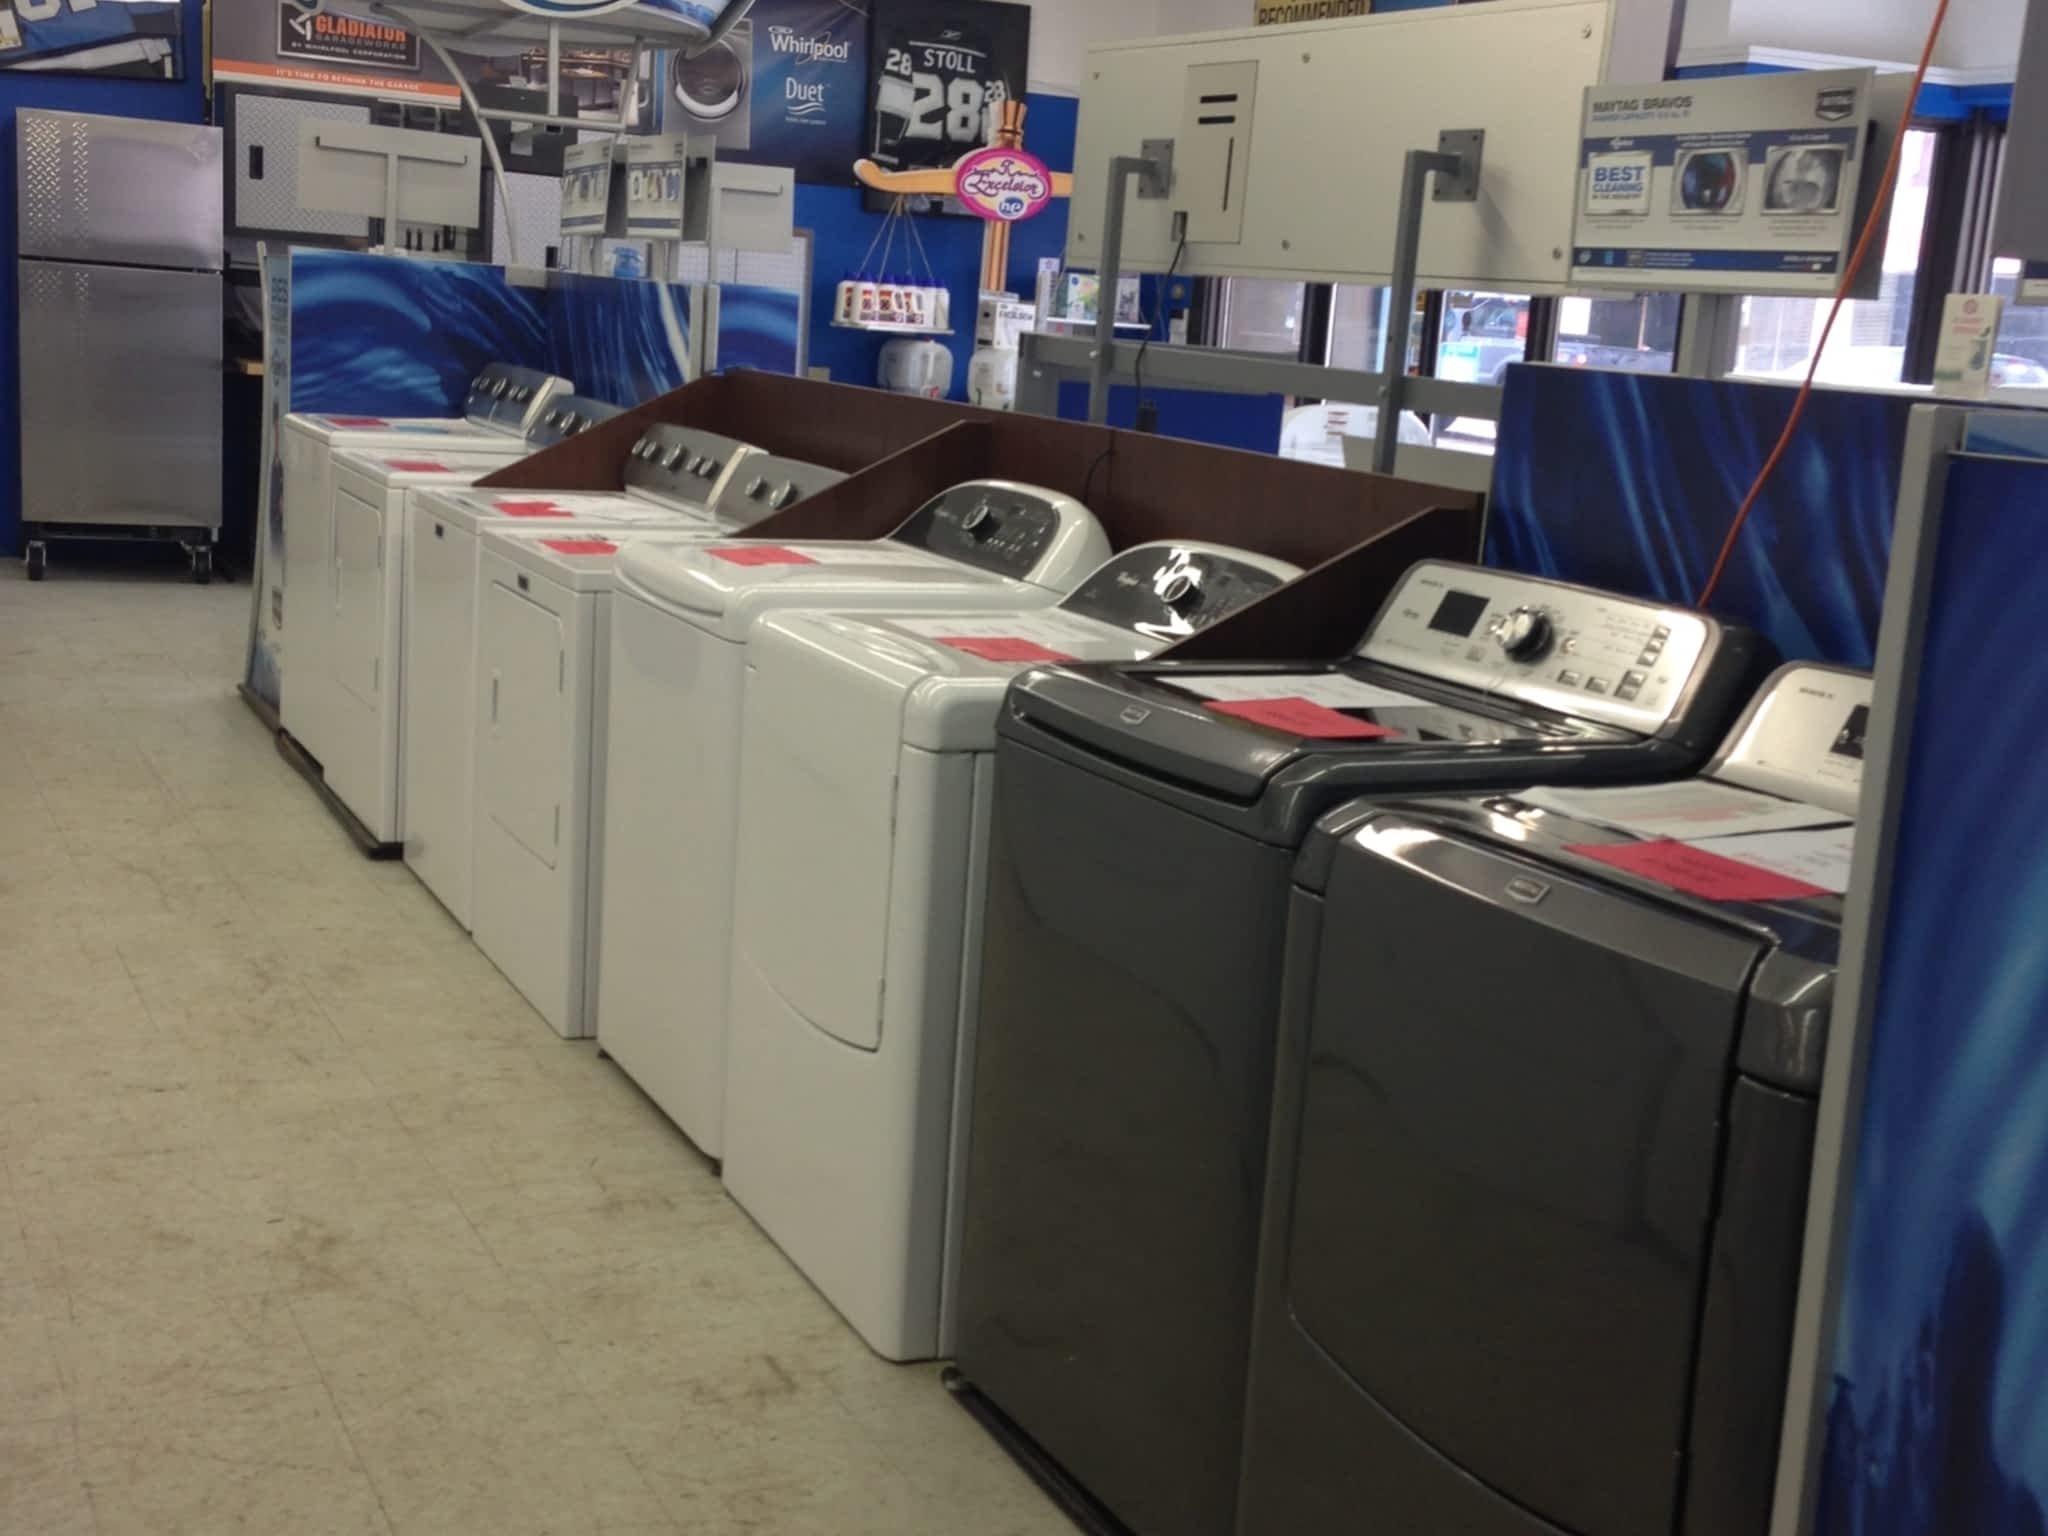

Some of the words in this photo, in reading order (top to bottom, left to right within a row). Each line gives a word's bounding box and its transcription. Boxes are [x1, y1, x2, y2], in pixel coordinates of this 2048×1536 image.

[316, 15, 407, 43] GLADIATOR
[770, 32, 848, 61] Whirlpool
[885, 48, 913, 75] 28
[923, 48, 976, 74] STOLL
[785, 77, 824, 102] Duet
[984, 80, 1006, 104] 28
[905, 72, 984, 143] 28
[966, 169, 1039, 197] Excelsior
[1594, 166, 1646, 181] BEST
[1592, 182, 1643, 193] CLEANING
